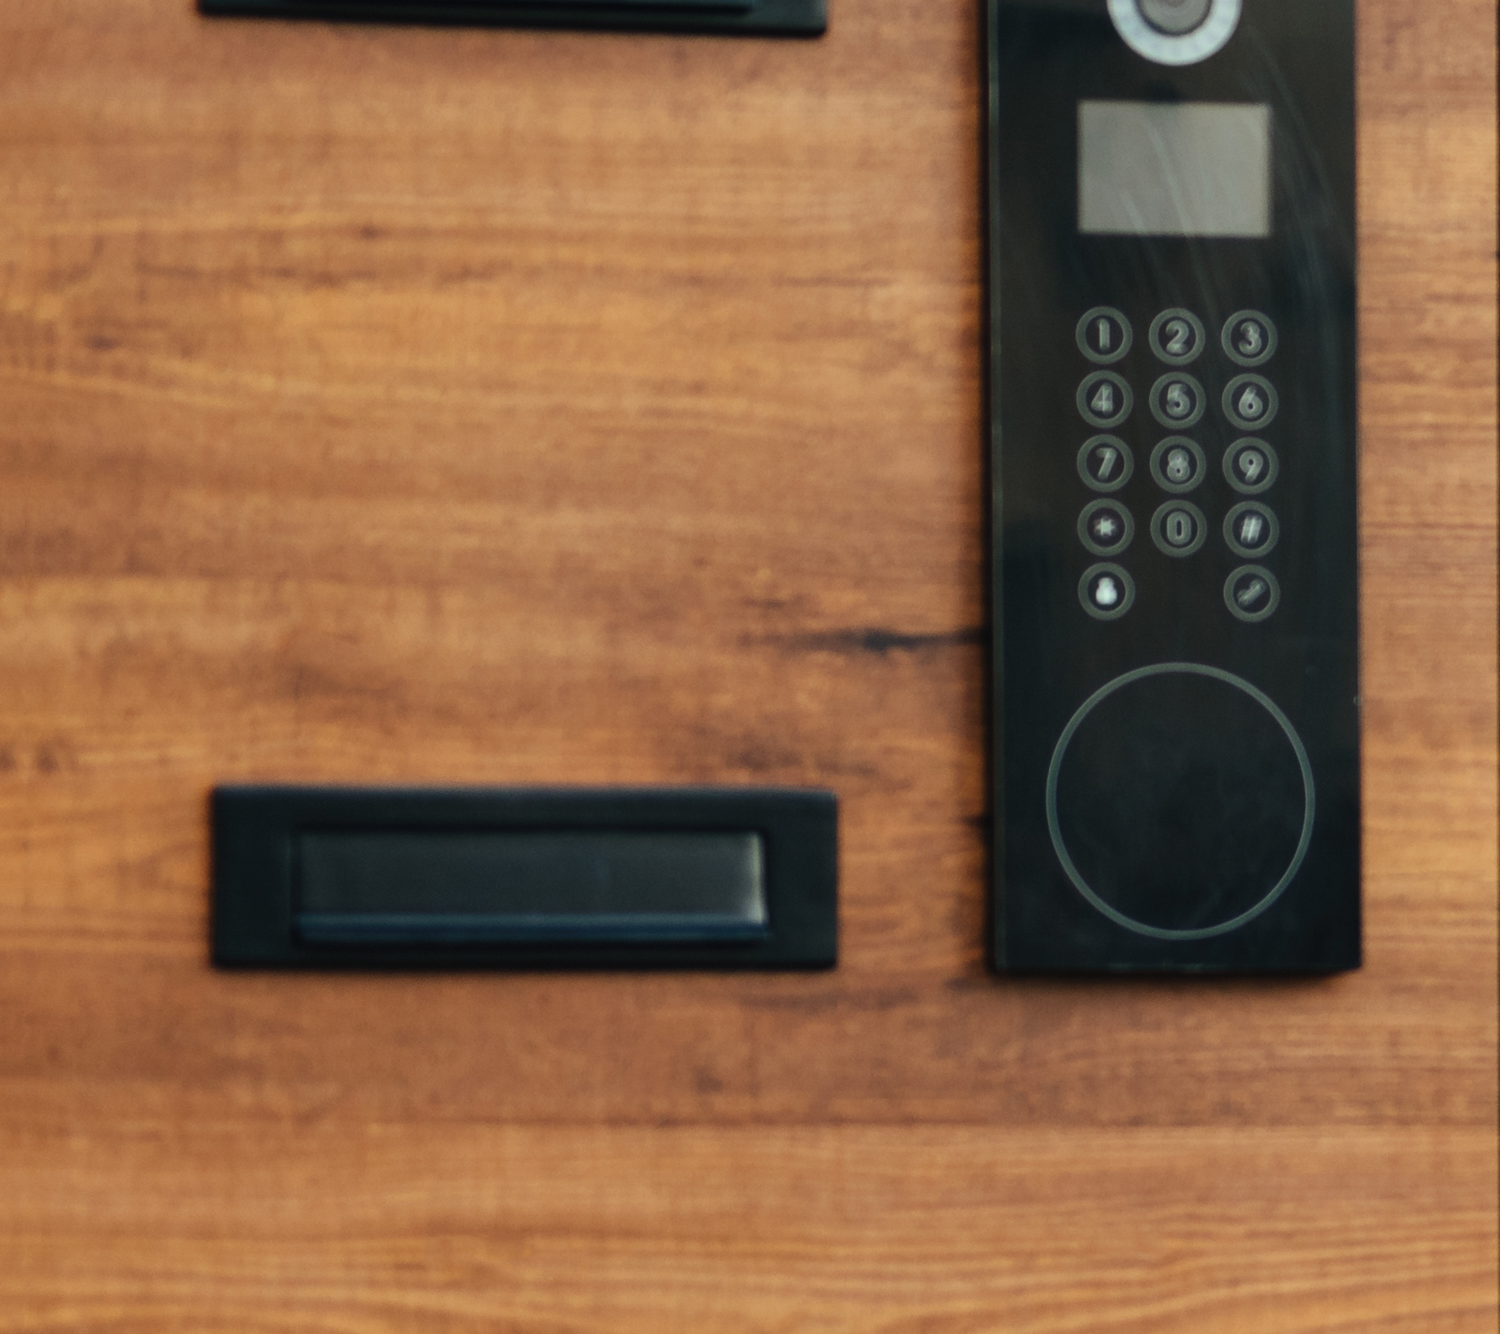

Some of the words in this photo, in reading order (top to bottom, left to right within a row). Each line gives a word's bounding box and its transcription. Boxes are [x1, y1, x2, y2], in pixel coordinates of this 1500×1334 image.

[1096, 318, 1110, 350] 1
[1166, 320, 1190, 354] 2
[1239, 322, 1262, 355] 3
[1091, 383, 1114, 415] 4
[1167, 383, 1191, 417] 5
[1239, 386, 1263, 418] 6
[1096, 447, 1117, 481] 7
[1166, 449, 1190, 482] 8
[1239, 451, 1264, 482] 9
[1166, 511, 1192, 545] 0
